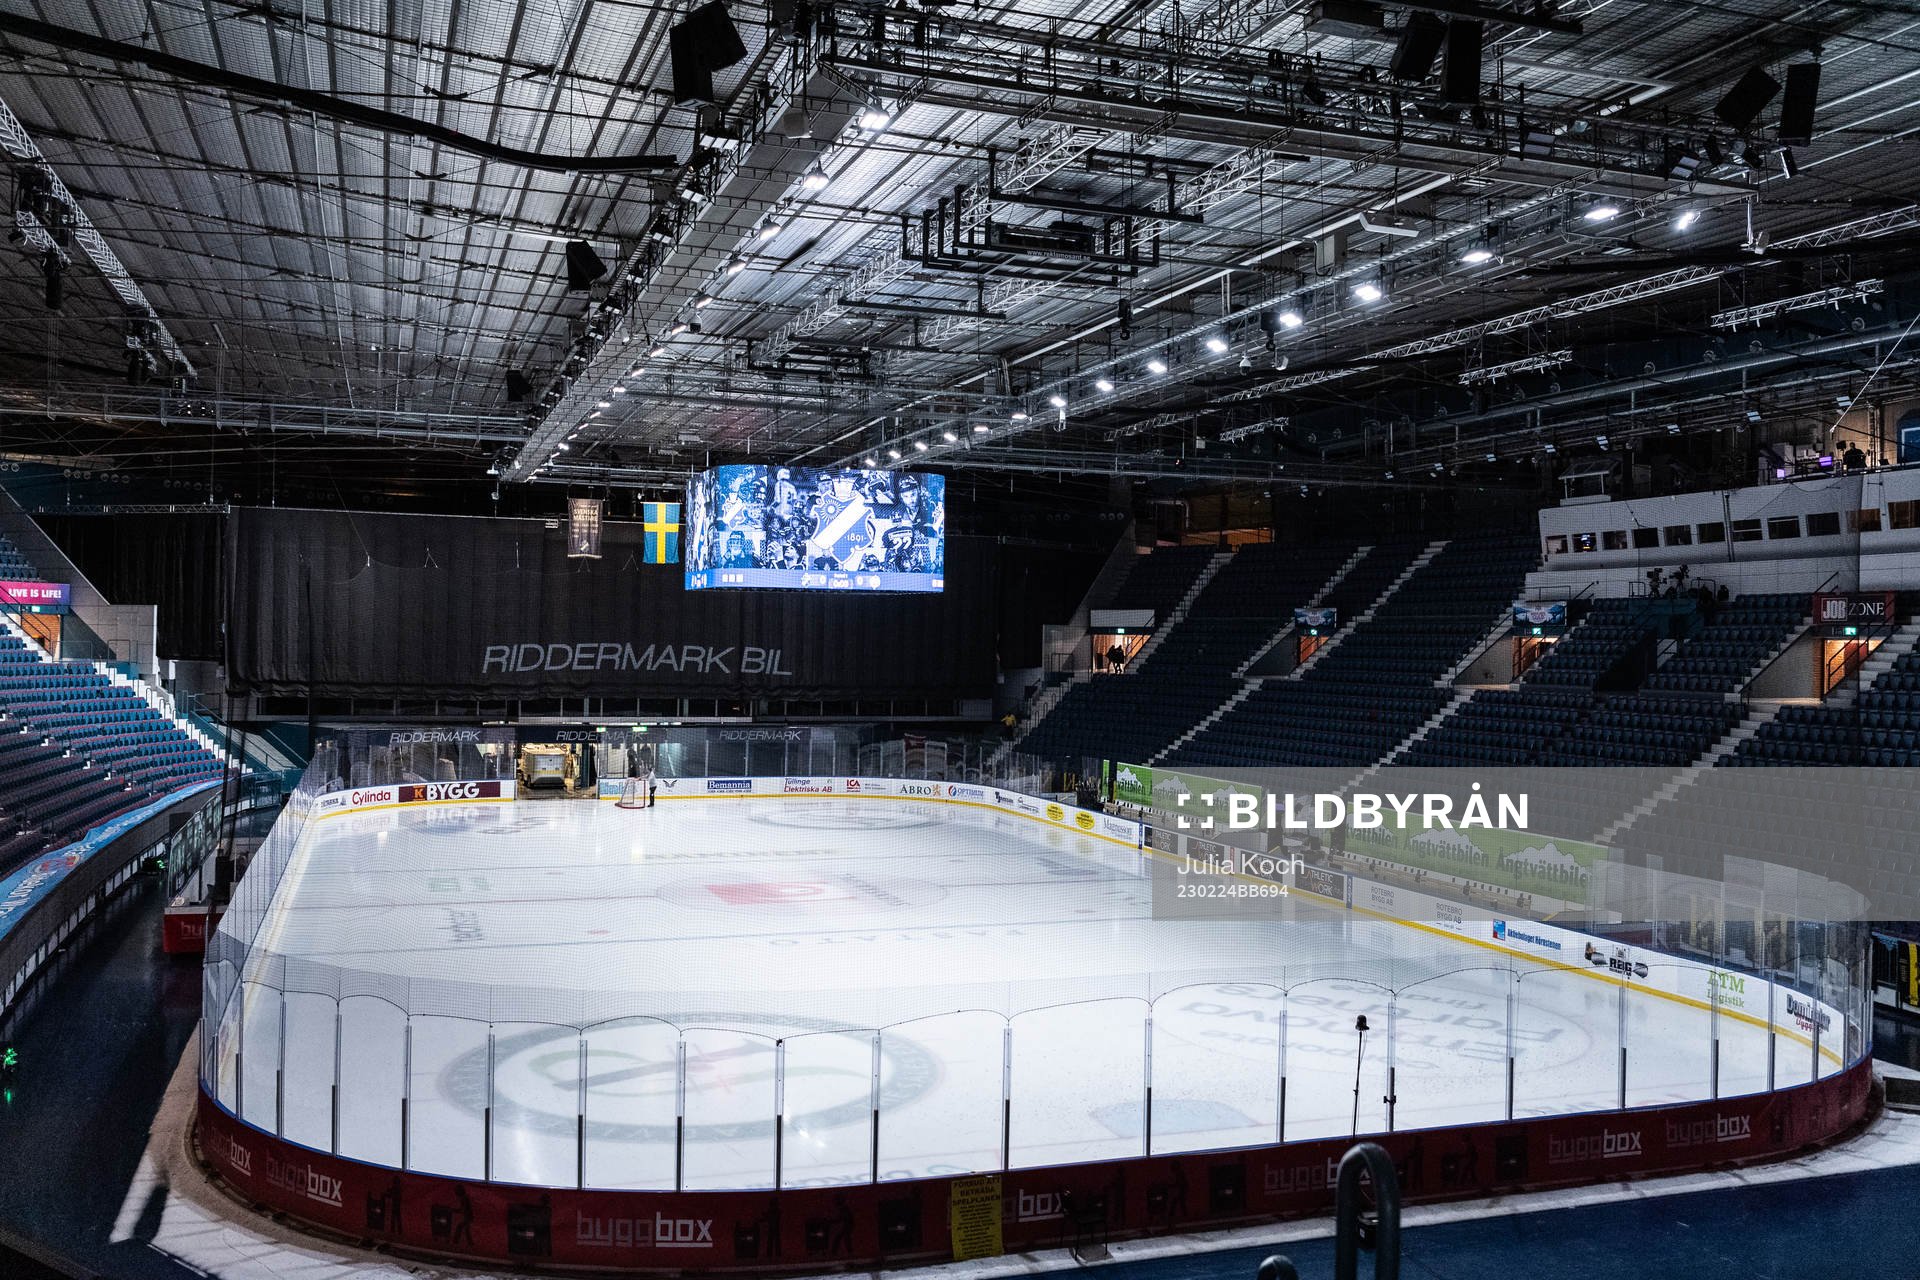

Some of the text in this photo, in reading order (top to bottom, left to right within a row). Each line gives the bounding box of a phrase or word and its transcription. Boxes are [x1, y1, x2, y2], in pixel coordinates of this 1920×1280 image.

[30, 589, 39, 598] IS
[41, 590, 61, 598] LIFE!
[1823, 600, 1846, 619] JOB
[482, 643, 793, 676] RIDDERMARK BIL
[390, 730, 481, 743] RIDDERMARK
[719, 730, 801, 741] RIDDERMARK
[708, 781, 751, 790] Bemannia
[846, 779, 860, 787] ICA
[426, 782, 480, 800] BYGG
[352, 790, 391, 806] Cylinda
[1371, 886, 1395, 899] ROTEBRO
[1371, 894, 1394, 906] BYGG AB
[1436, 903, 1463, 916] ROTEBRO
[1436, 911, 1462, 924] BYGG AB
[1666, 1113, 1752, 1150] byggbox
[1549, 1128, 1642, 1165] byggbox
[576, 1209, 714, 1248] byggbox
